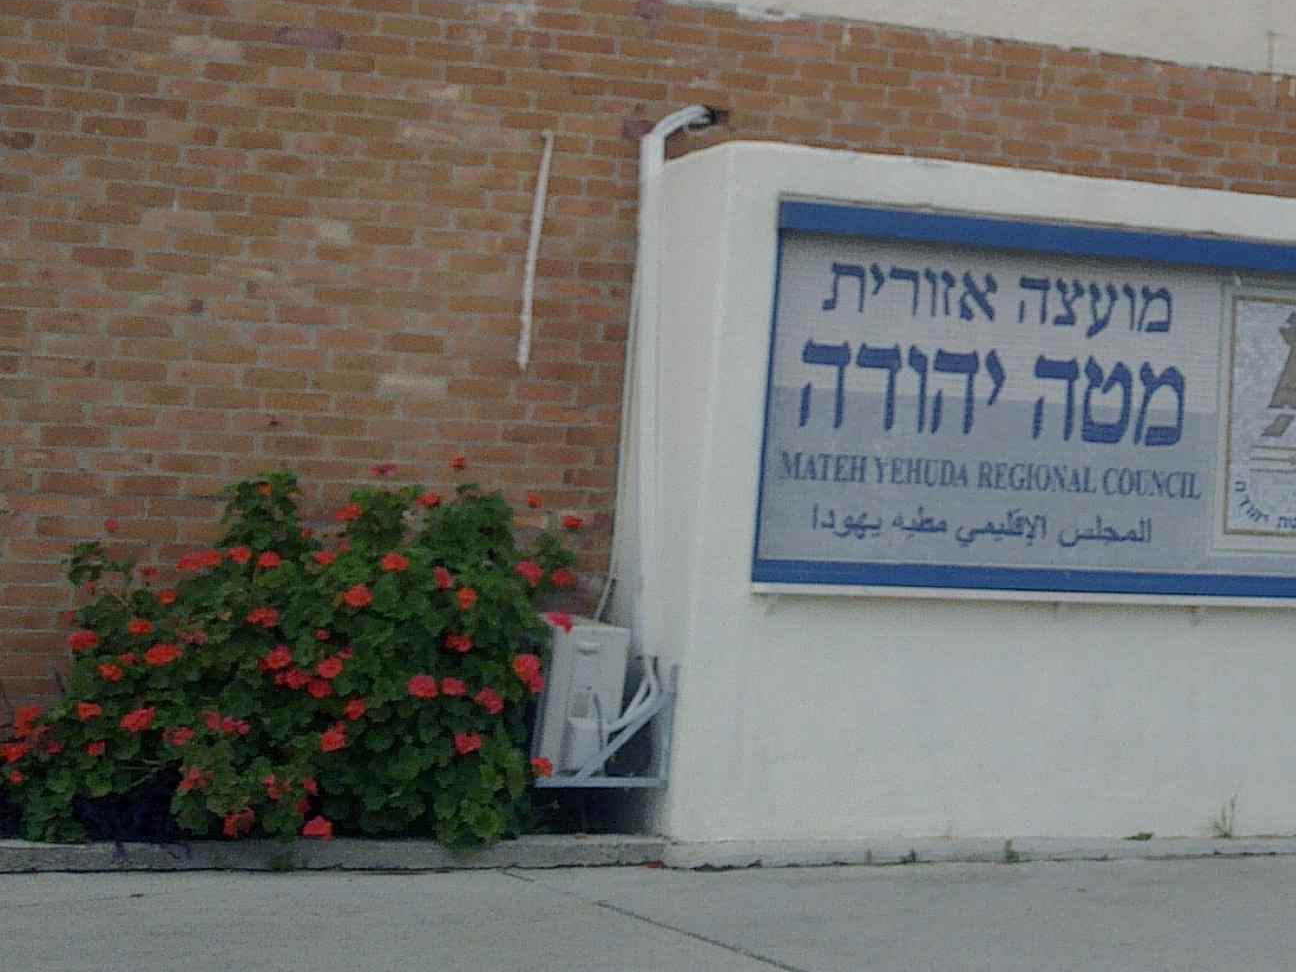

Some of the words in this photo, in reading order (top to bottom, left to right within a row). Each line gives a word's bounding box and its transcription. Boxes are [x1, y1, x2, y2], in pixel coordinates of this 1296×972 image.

[821, 261, 999, 322] אזורית
[1017, 276, 1173, 338] מועצה
[799, 337, 1007, 436] יהודה
[1033, 355, 1186, 448] מטה
[781, 451, 868, 484] MATEH
[873, 456, 969, 488] YEHUDA
[976, 460, 1097, 494] REGIONAL
[1102, 467, 1203, 500] COUNCIL
[1057, 514, 1153, 548] المجلس
